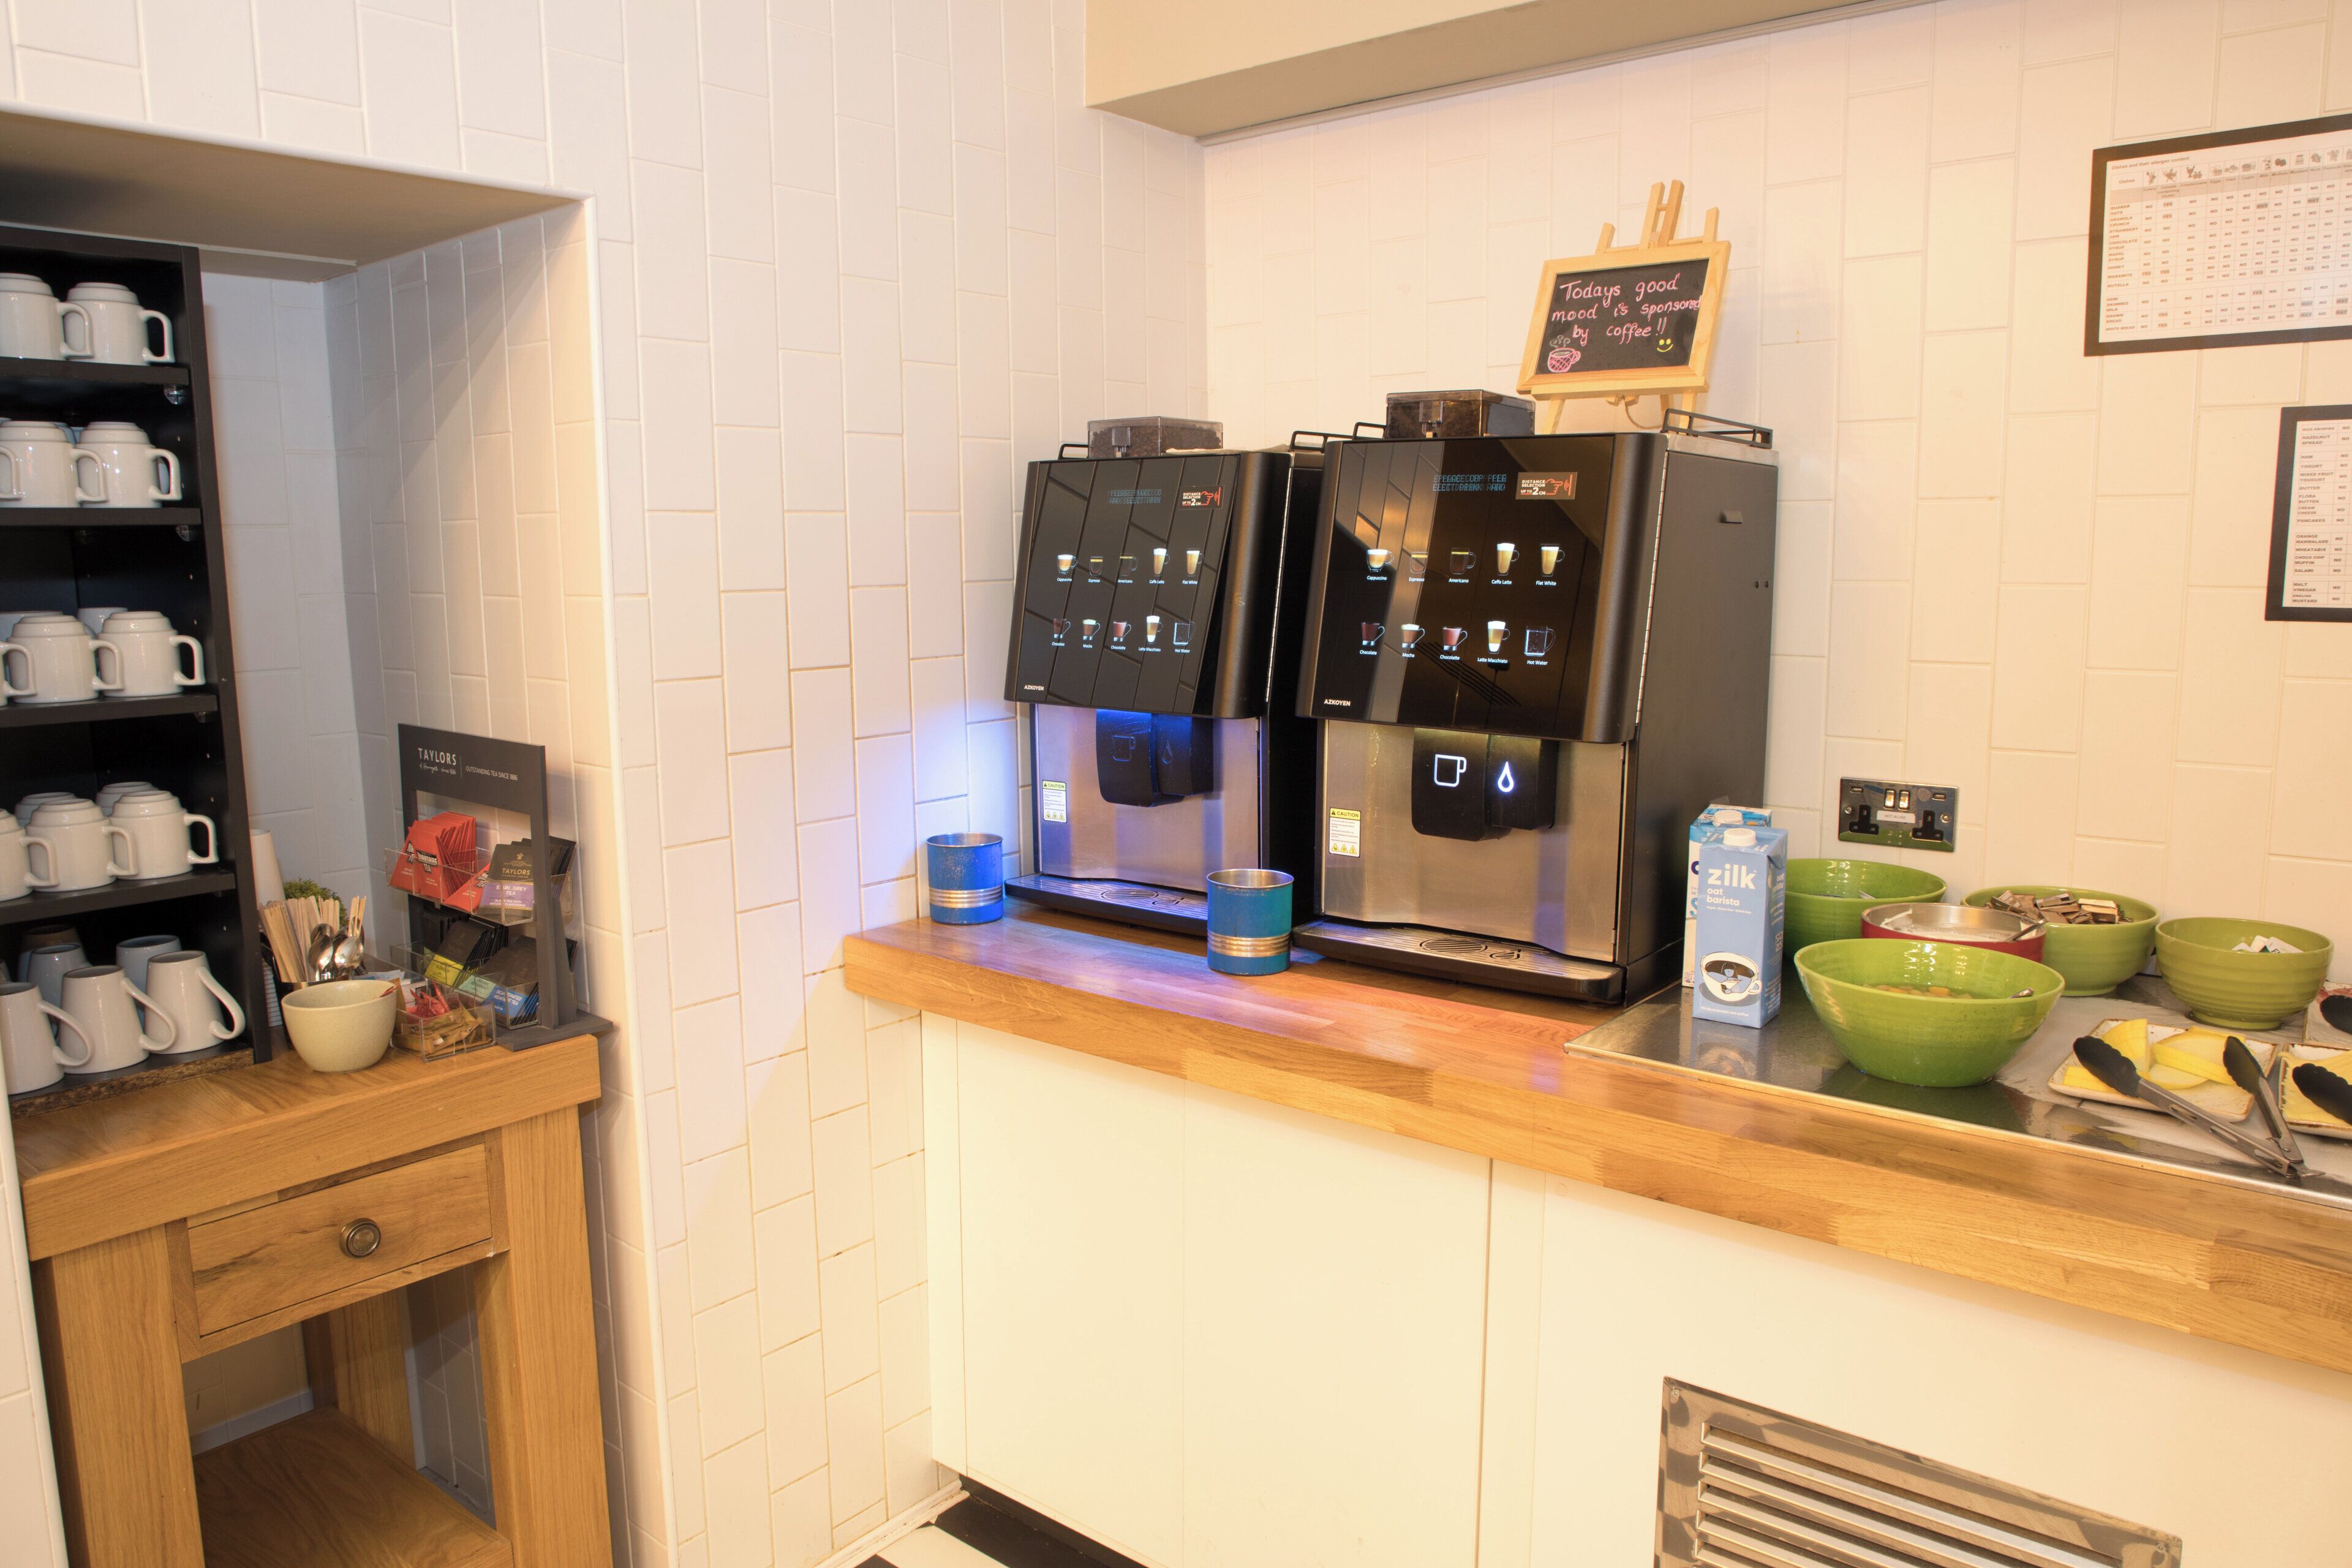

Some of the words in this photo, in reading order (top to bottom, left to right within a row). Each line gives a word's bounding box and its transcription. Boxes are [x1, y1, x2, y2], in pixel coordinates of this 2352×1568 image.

[1560, 281, 1621, 307] Todays
[1636, 273, 1680, 301] good
[1551, 304, 1597, 321] mood
[1614, 303, 1628, 317] is
[1573, 325, 1589, 346] by
[1532, 487, 1539, 496] 2
[418, 748, 456, 766] TAYLORS
[466, 766, 490, 775] OUTSTANDING
[1708, 864, 1756, 889] zilk
[1706, 895, 1740, 906] barista
